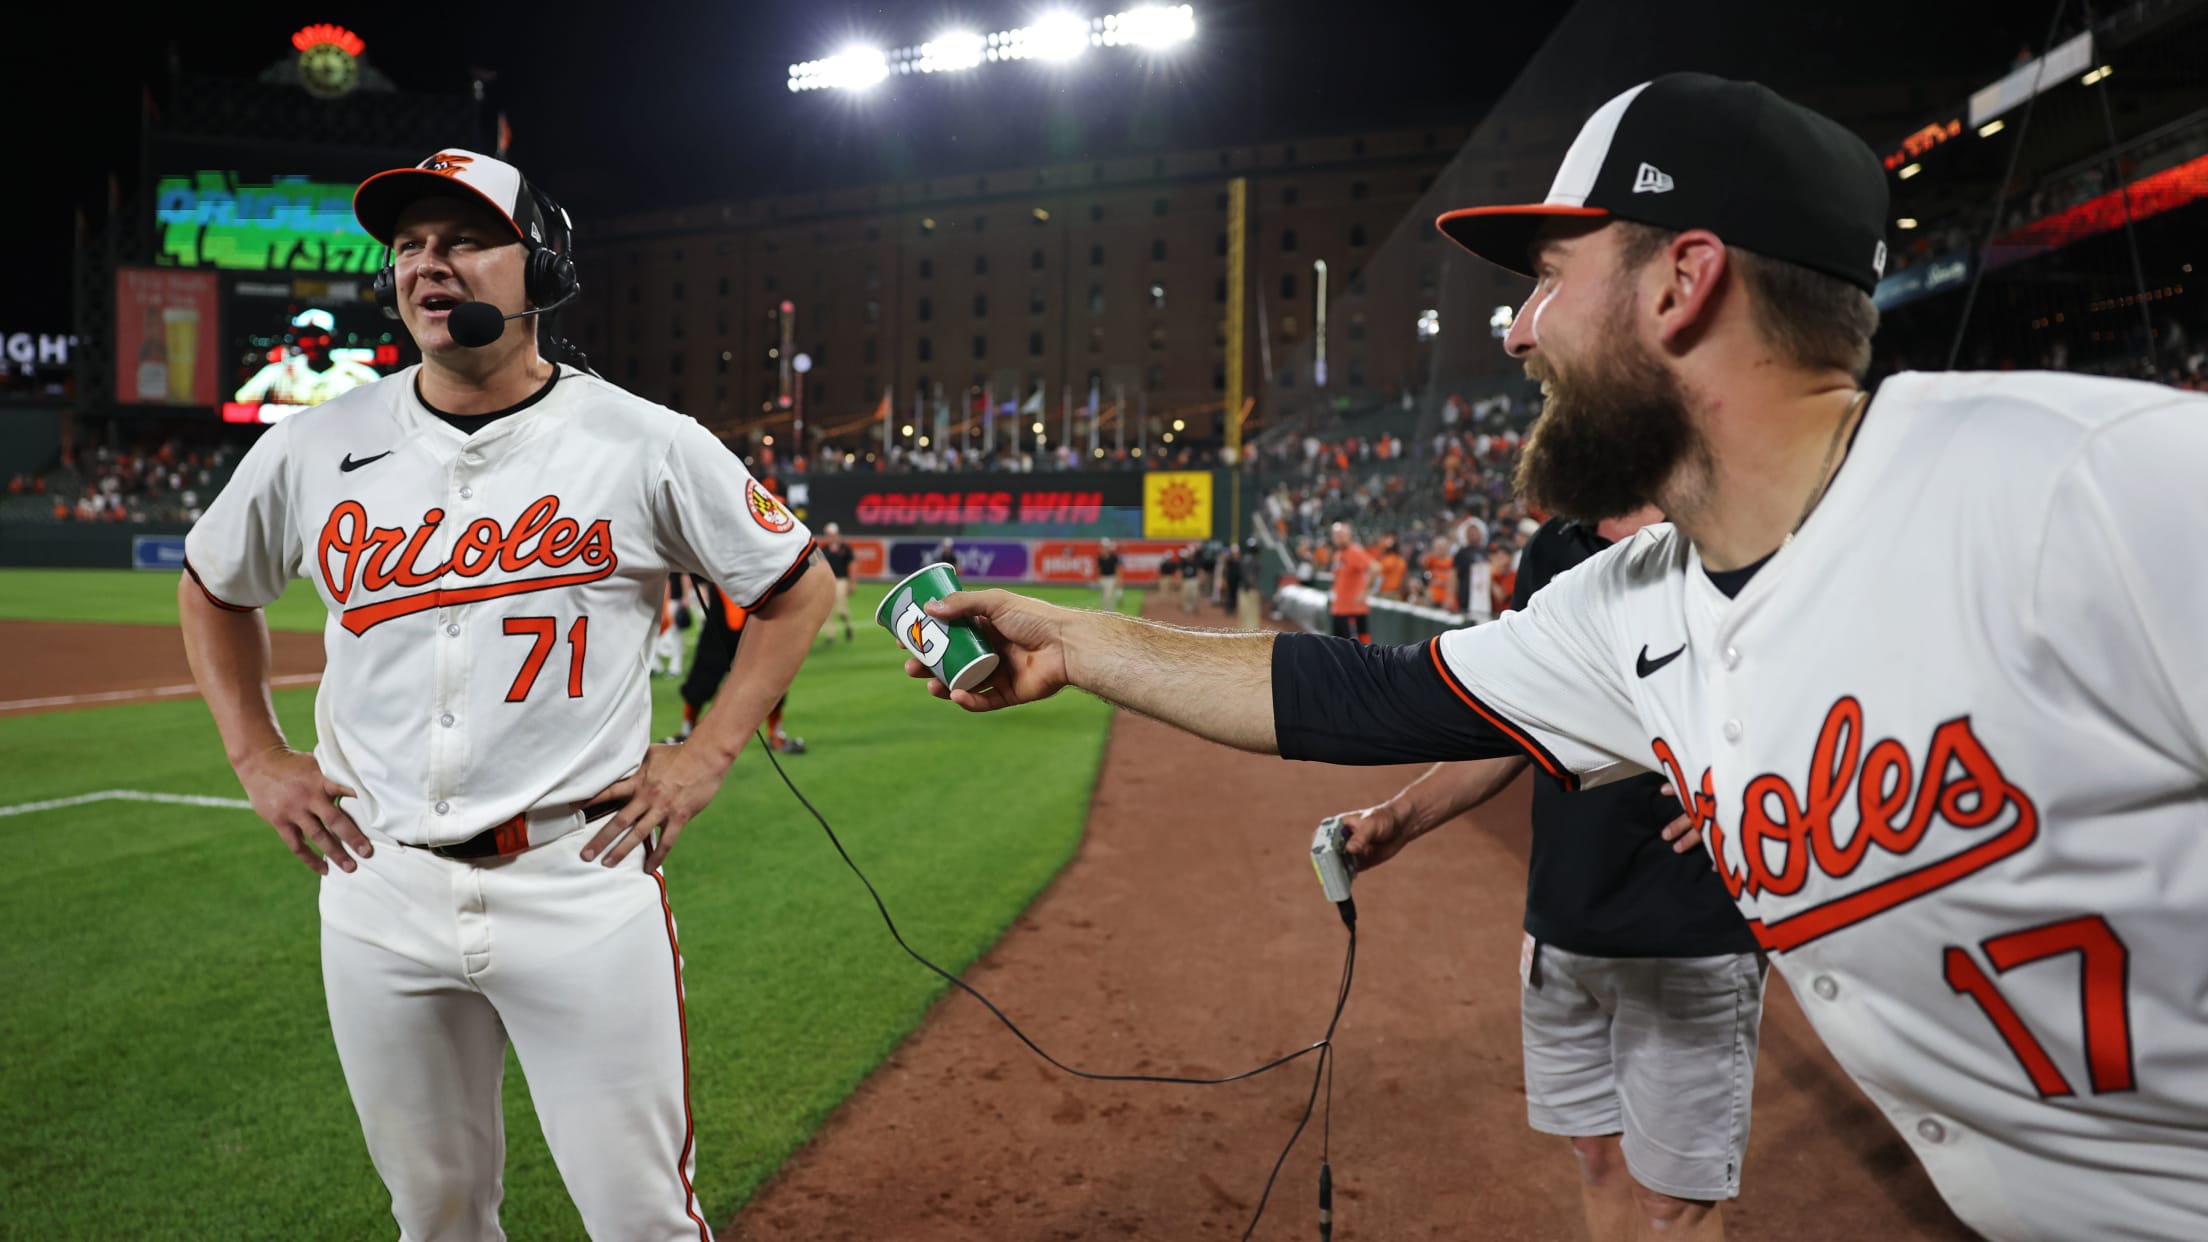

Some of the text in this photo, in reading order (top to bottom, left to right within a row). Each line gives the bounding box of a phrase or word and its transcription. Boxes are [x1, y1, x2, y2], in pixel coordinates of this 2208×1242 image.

[318, 495, 617, 605] Orioles
[856, 490, 1104, 525] ORIOLES WIN
[502, 616, 588, 703] 71
[896, 601, 950, 668] G
[1943, 914, 2137, 1098] 17
